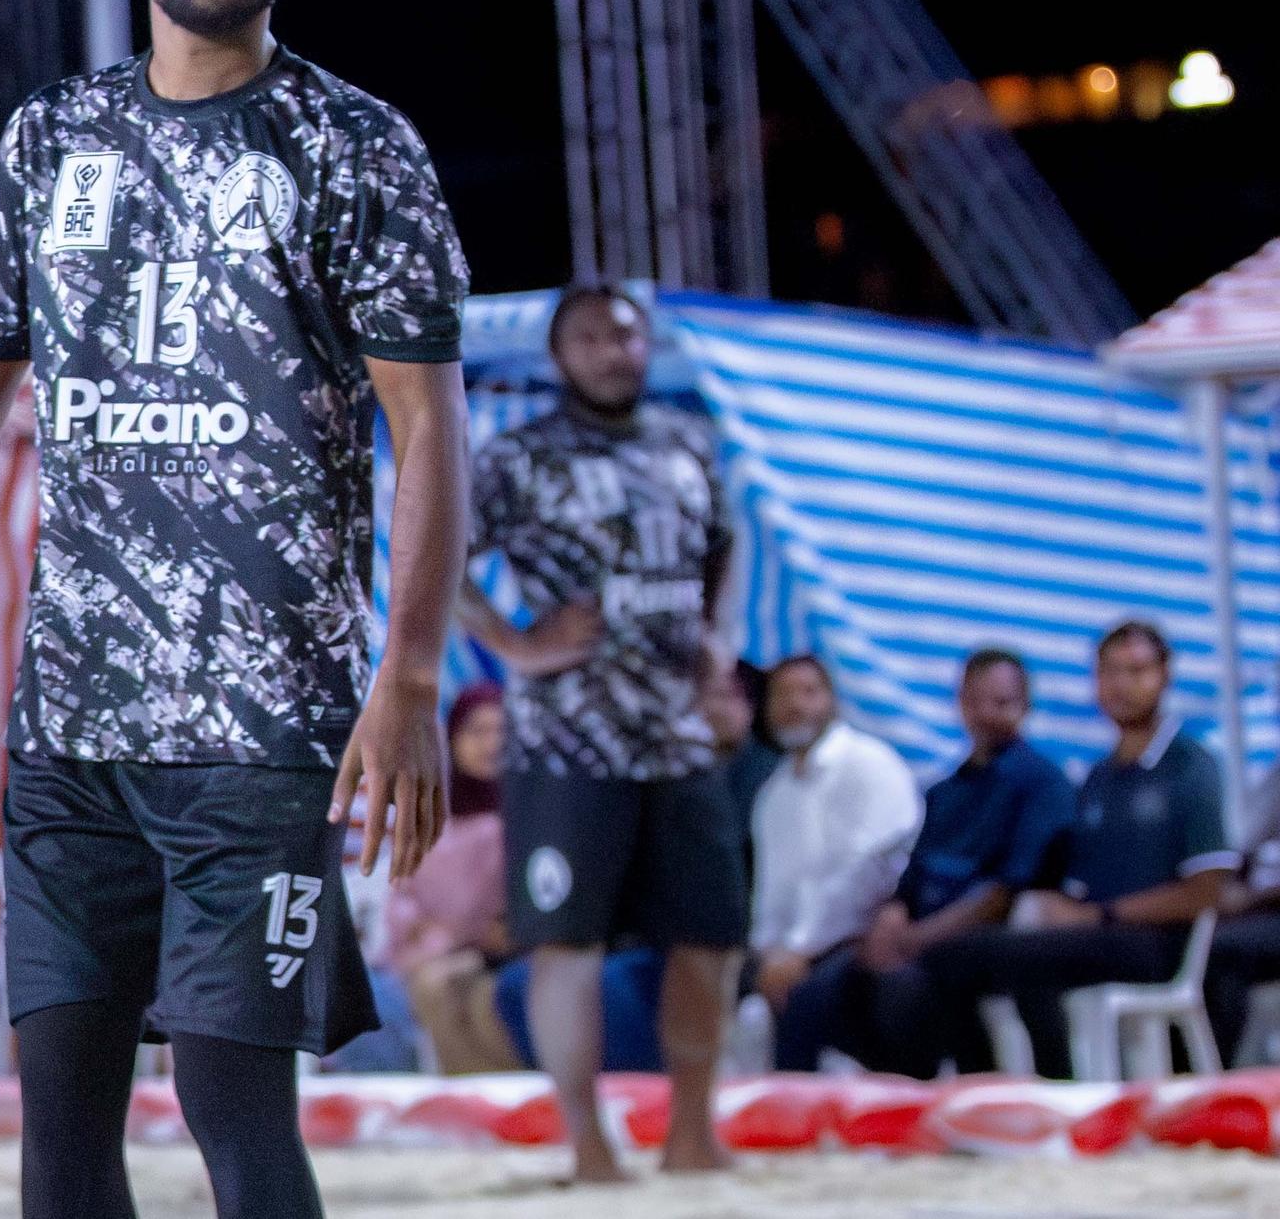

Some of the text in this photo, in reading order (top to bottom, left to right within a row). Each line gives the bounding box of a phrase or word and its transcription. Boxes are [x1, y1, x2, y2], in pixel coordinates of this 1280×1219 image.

[64, 211, 95, 233] BHC
[127, 261, 198, 366] 13
[55, 377, 249, 444] Pizano
[96, 451, 208, 473] Italiano
[262, 871, 322, 949] 13
